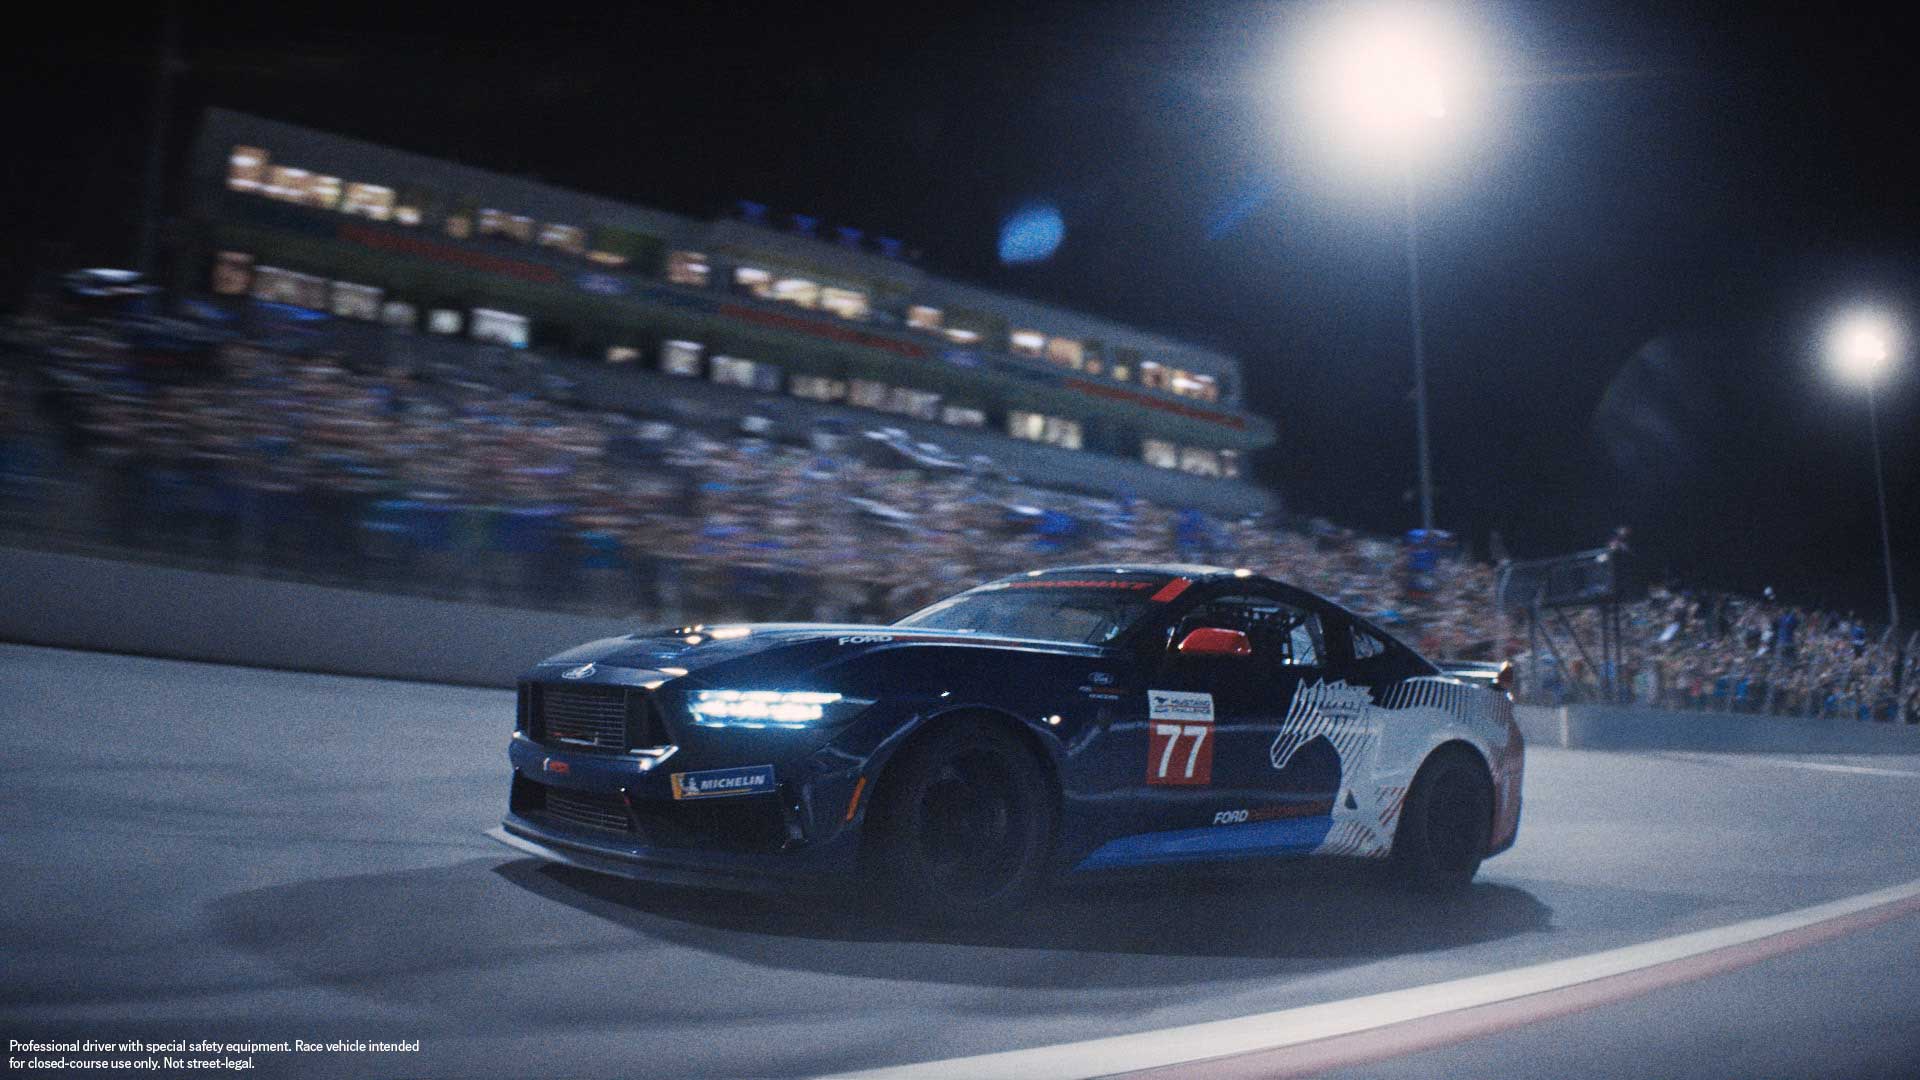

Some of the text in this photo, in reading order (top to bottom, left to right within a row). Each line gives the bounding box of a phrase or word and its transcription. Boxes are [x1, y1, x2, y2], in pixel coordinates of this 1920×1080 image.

[838, 635, 893, 646] FORD
[1156, 724, 1207, 778] 77
[701, 775, 766, 790] MICHELIN
[1212, 809, 1249, 825] FORD
